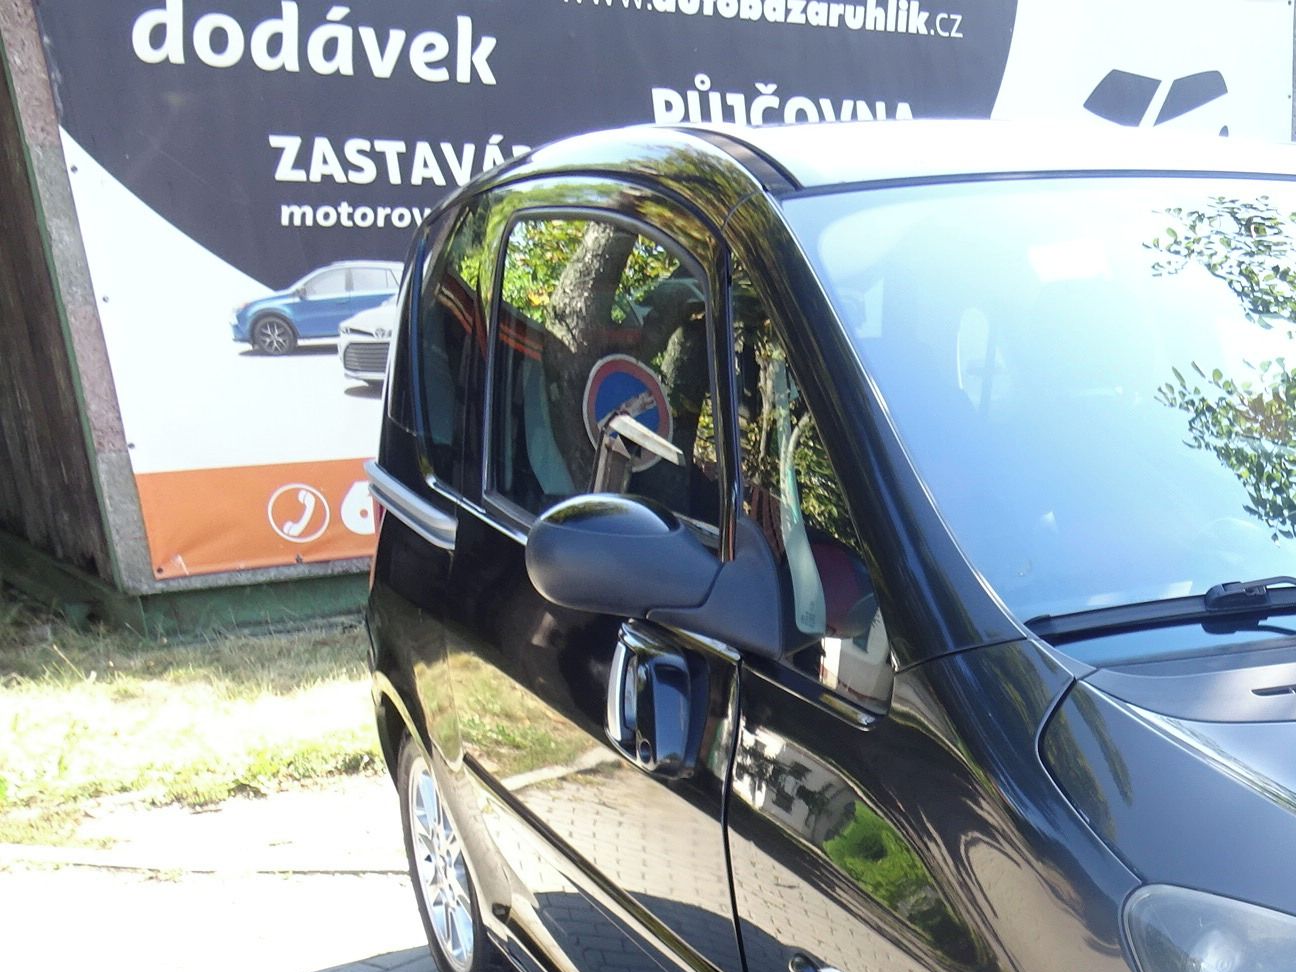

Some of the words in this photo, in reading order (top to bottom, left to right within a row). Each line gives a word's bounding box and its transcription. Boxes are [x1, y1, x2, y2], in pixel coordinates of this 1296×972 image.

[132, 0, 497, 85] dodávek
[564, 0, 963, 38] .utobazaruhlik.cz
[268, 134, 533, 187] ZASTAVÁ
